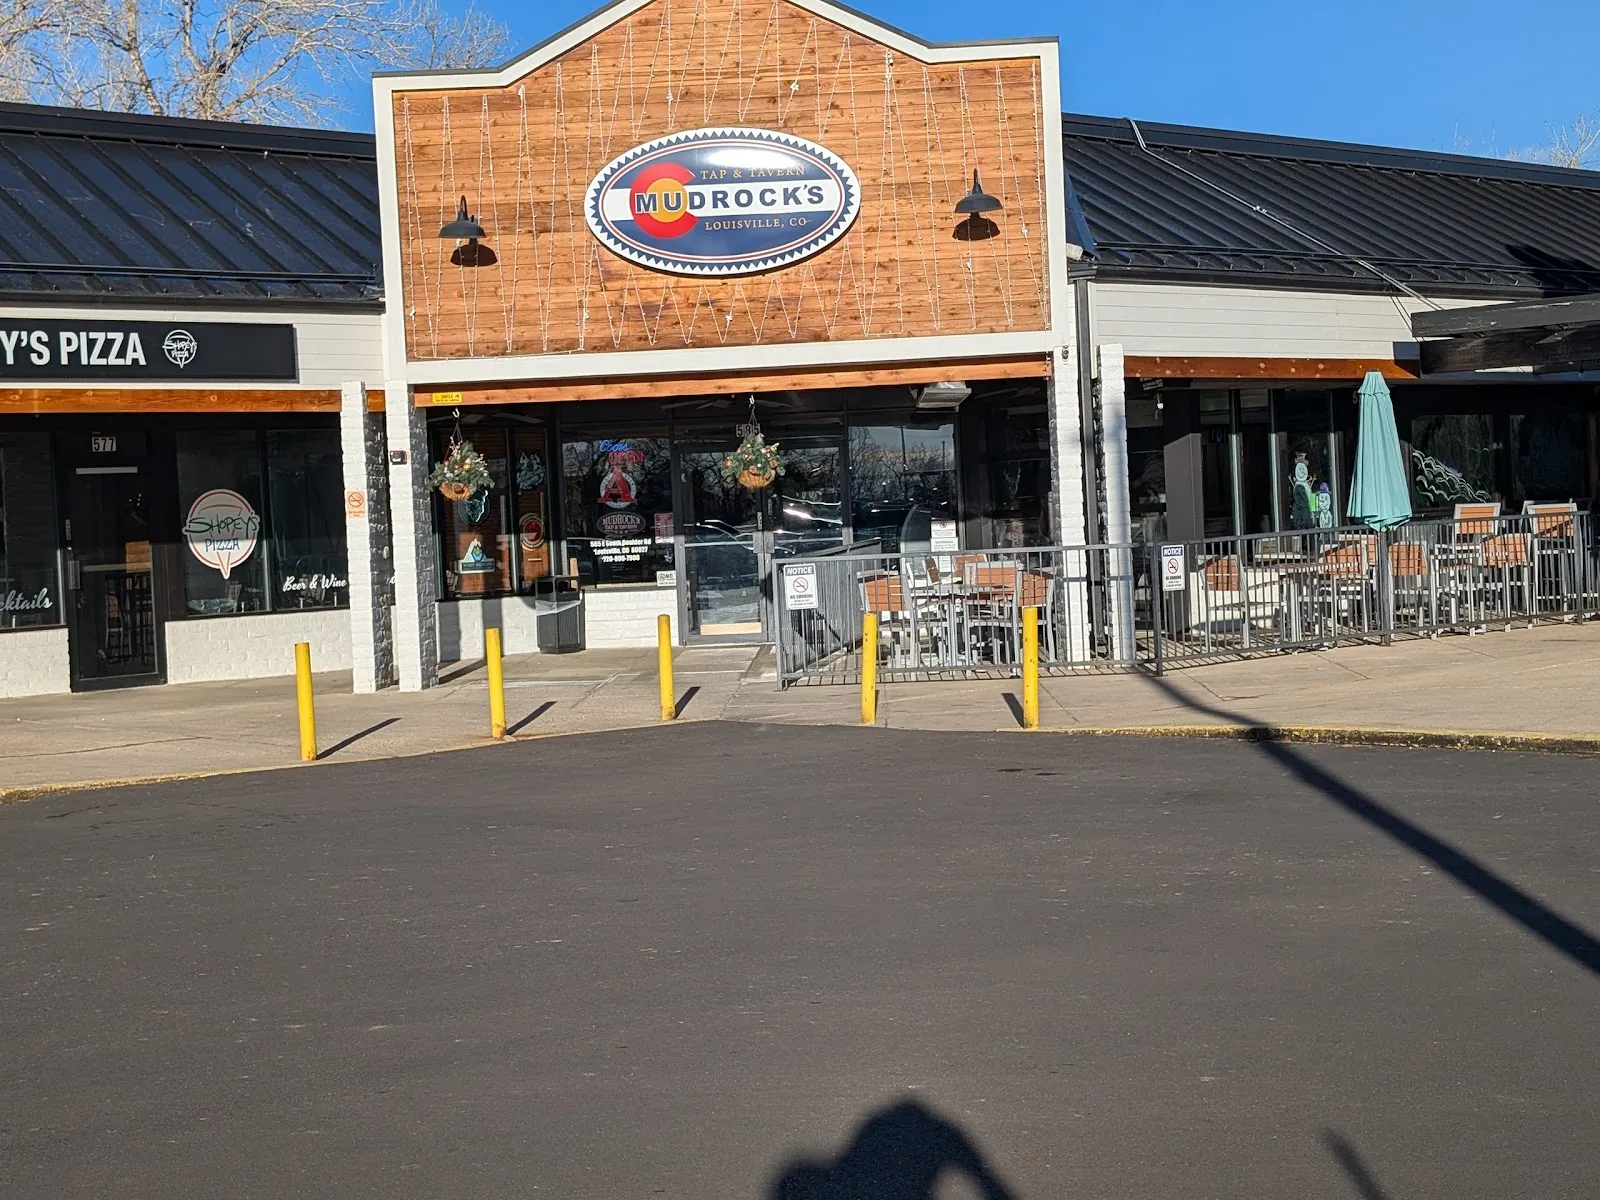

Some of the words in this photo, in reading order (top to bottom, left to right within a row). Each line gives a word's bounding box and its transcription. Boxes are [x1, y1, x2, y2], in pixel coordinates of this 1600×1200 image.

[700, 169, 727, 180] TAP
[733, 169, 742, 178] &
[748, 166, 806, 178] TAVERN
[635, 184, 824, 214] MUDROCK'S
[704, 218, 785, 231] LOUISVILLE,
[789, 217, 808, 227] CO
[0, 330, 50, 366] Y'S
[59, 331, 147, 366] PIZZA
[93, 437, 115, 451] 577
[602, 514, 641, 525] MUDROCK'S
[205, 537, 240, 552] PIZZA
[1163, 547, 1182, 556] NOTICE
[787, 566, 813, 575] NOTICE
[282, 576, 307, 592] Beer
[308, 574, 319, 590] &
[321, 573, 347, 589] Wine
